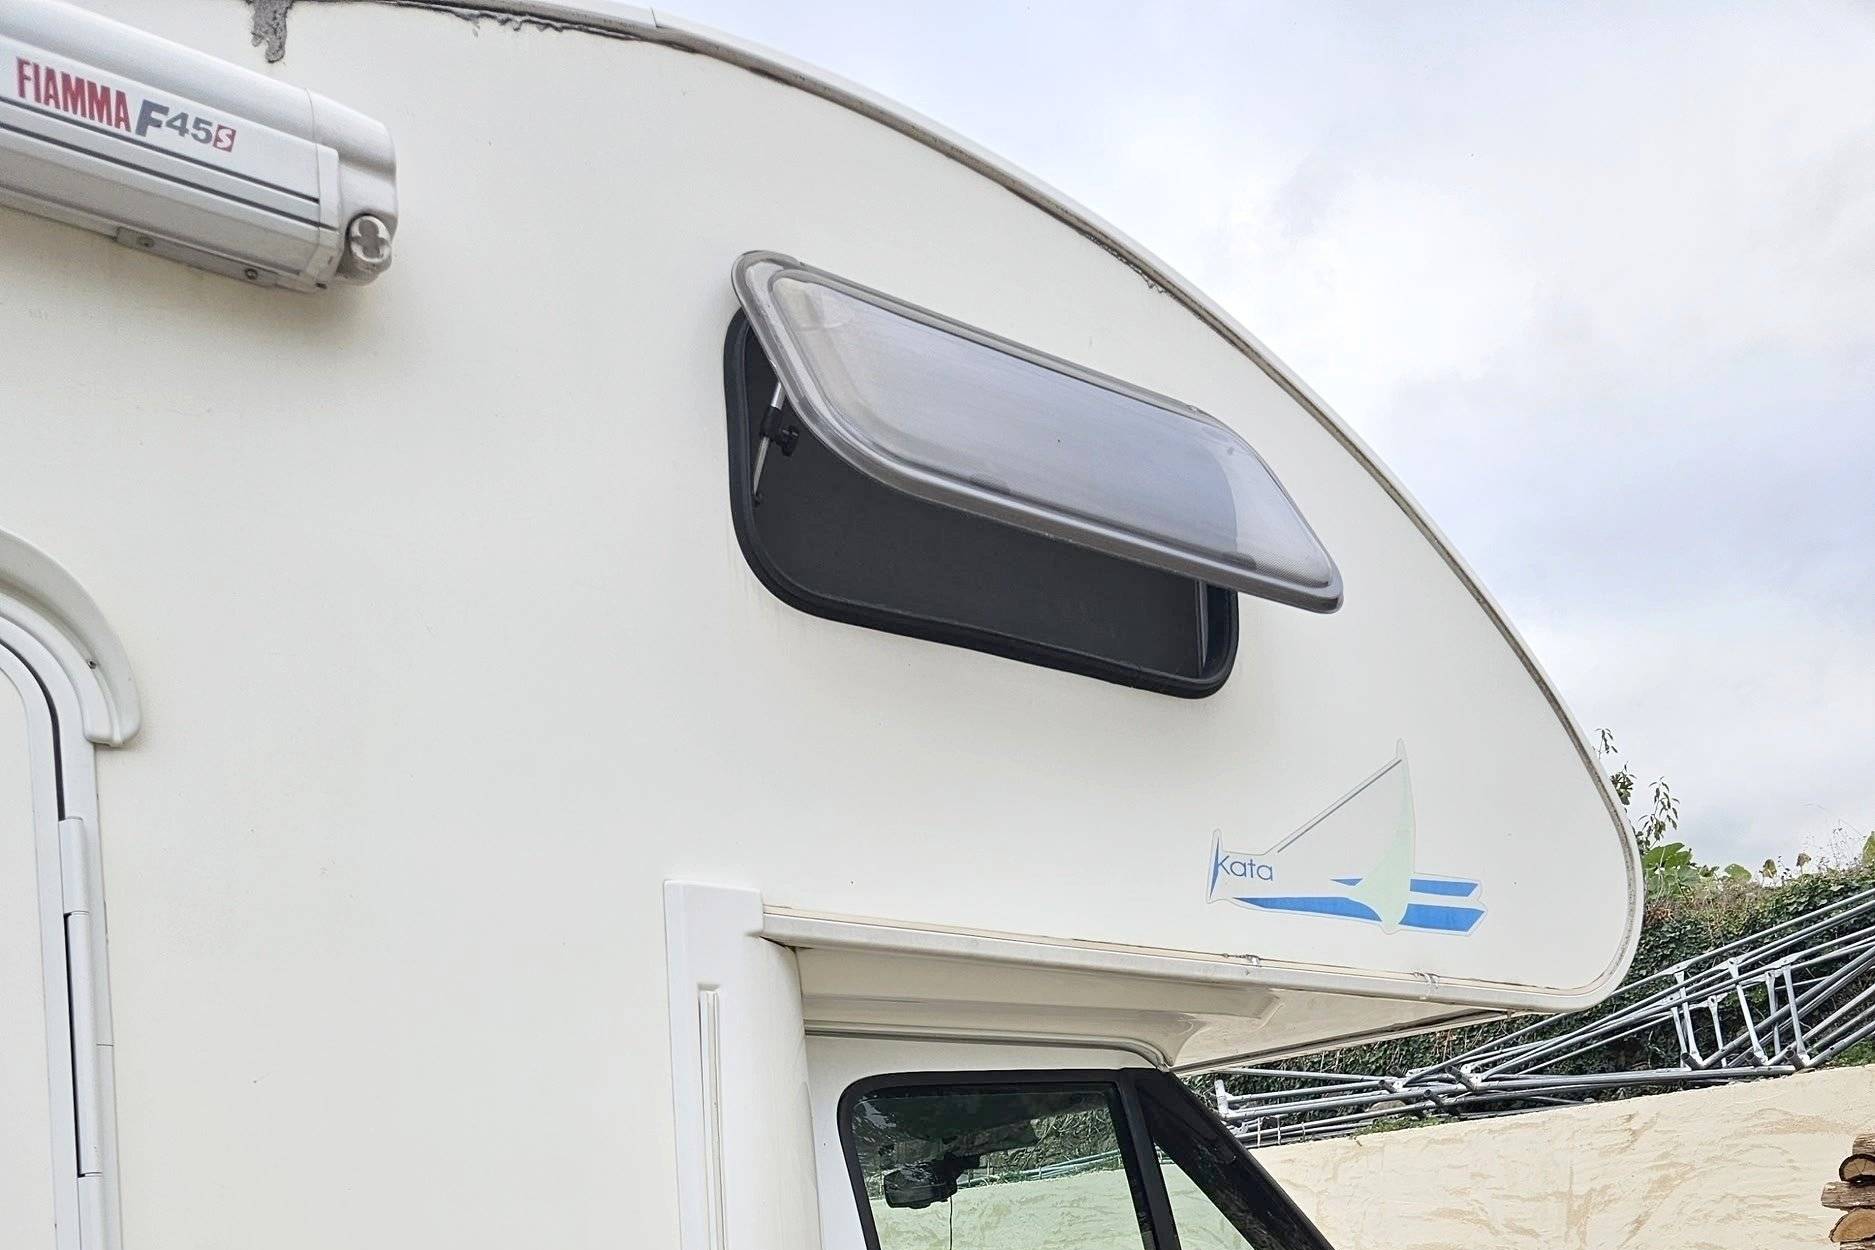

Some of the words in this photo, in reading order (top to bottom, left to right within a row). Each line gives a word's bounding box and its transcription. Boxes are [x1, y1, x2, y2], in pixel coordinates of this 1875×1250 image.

[16, 56, 132, 133] FIAMMA
[135, 98, 237, 153] F45S
[1209, 837, 1274, 899] Kata
